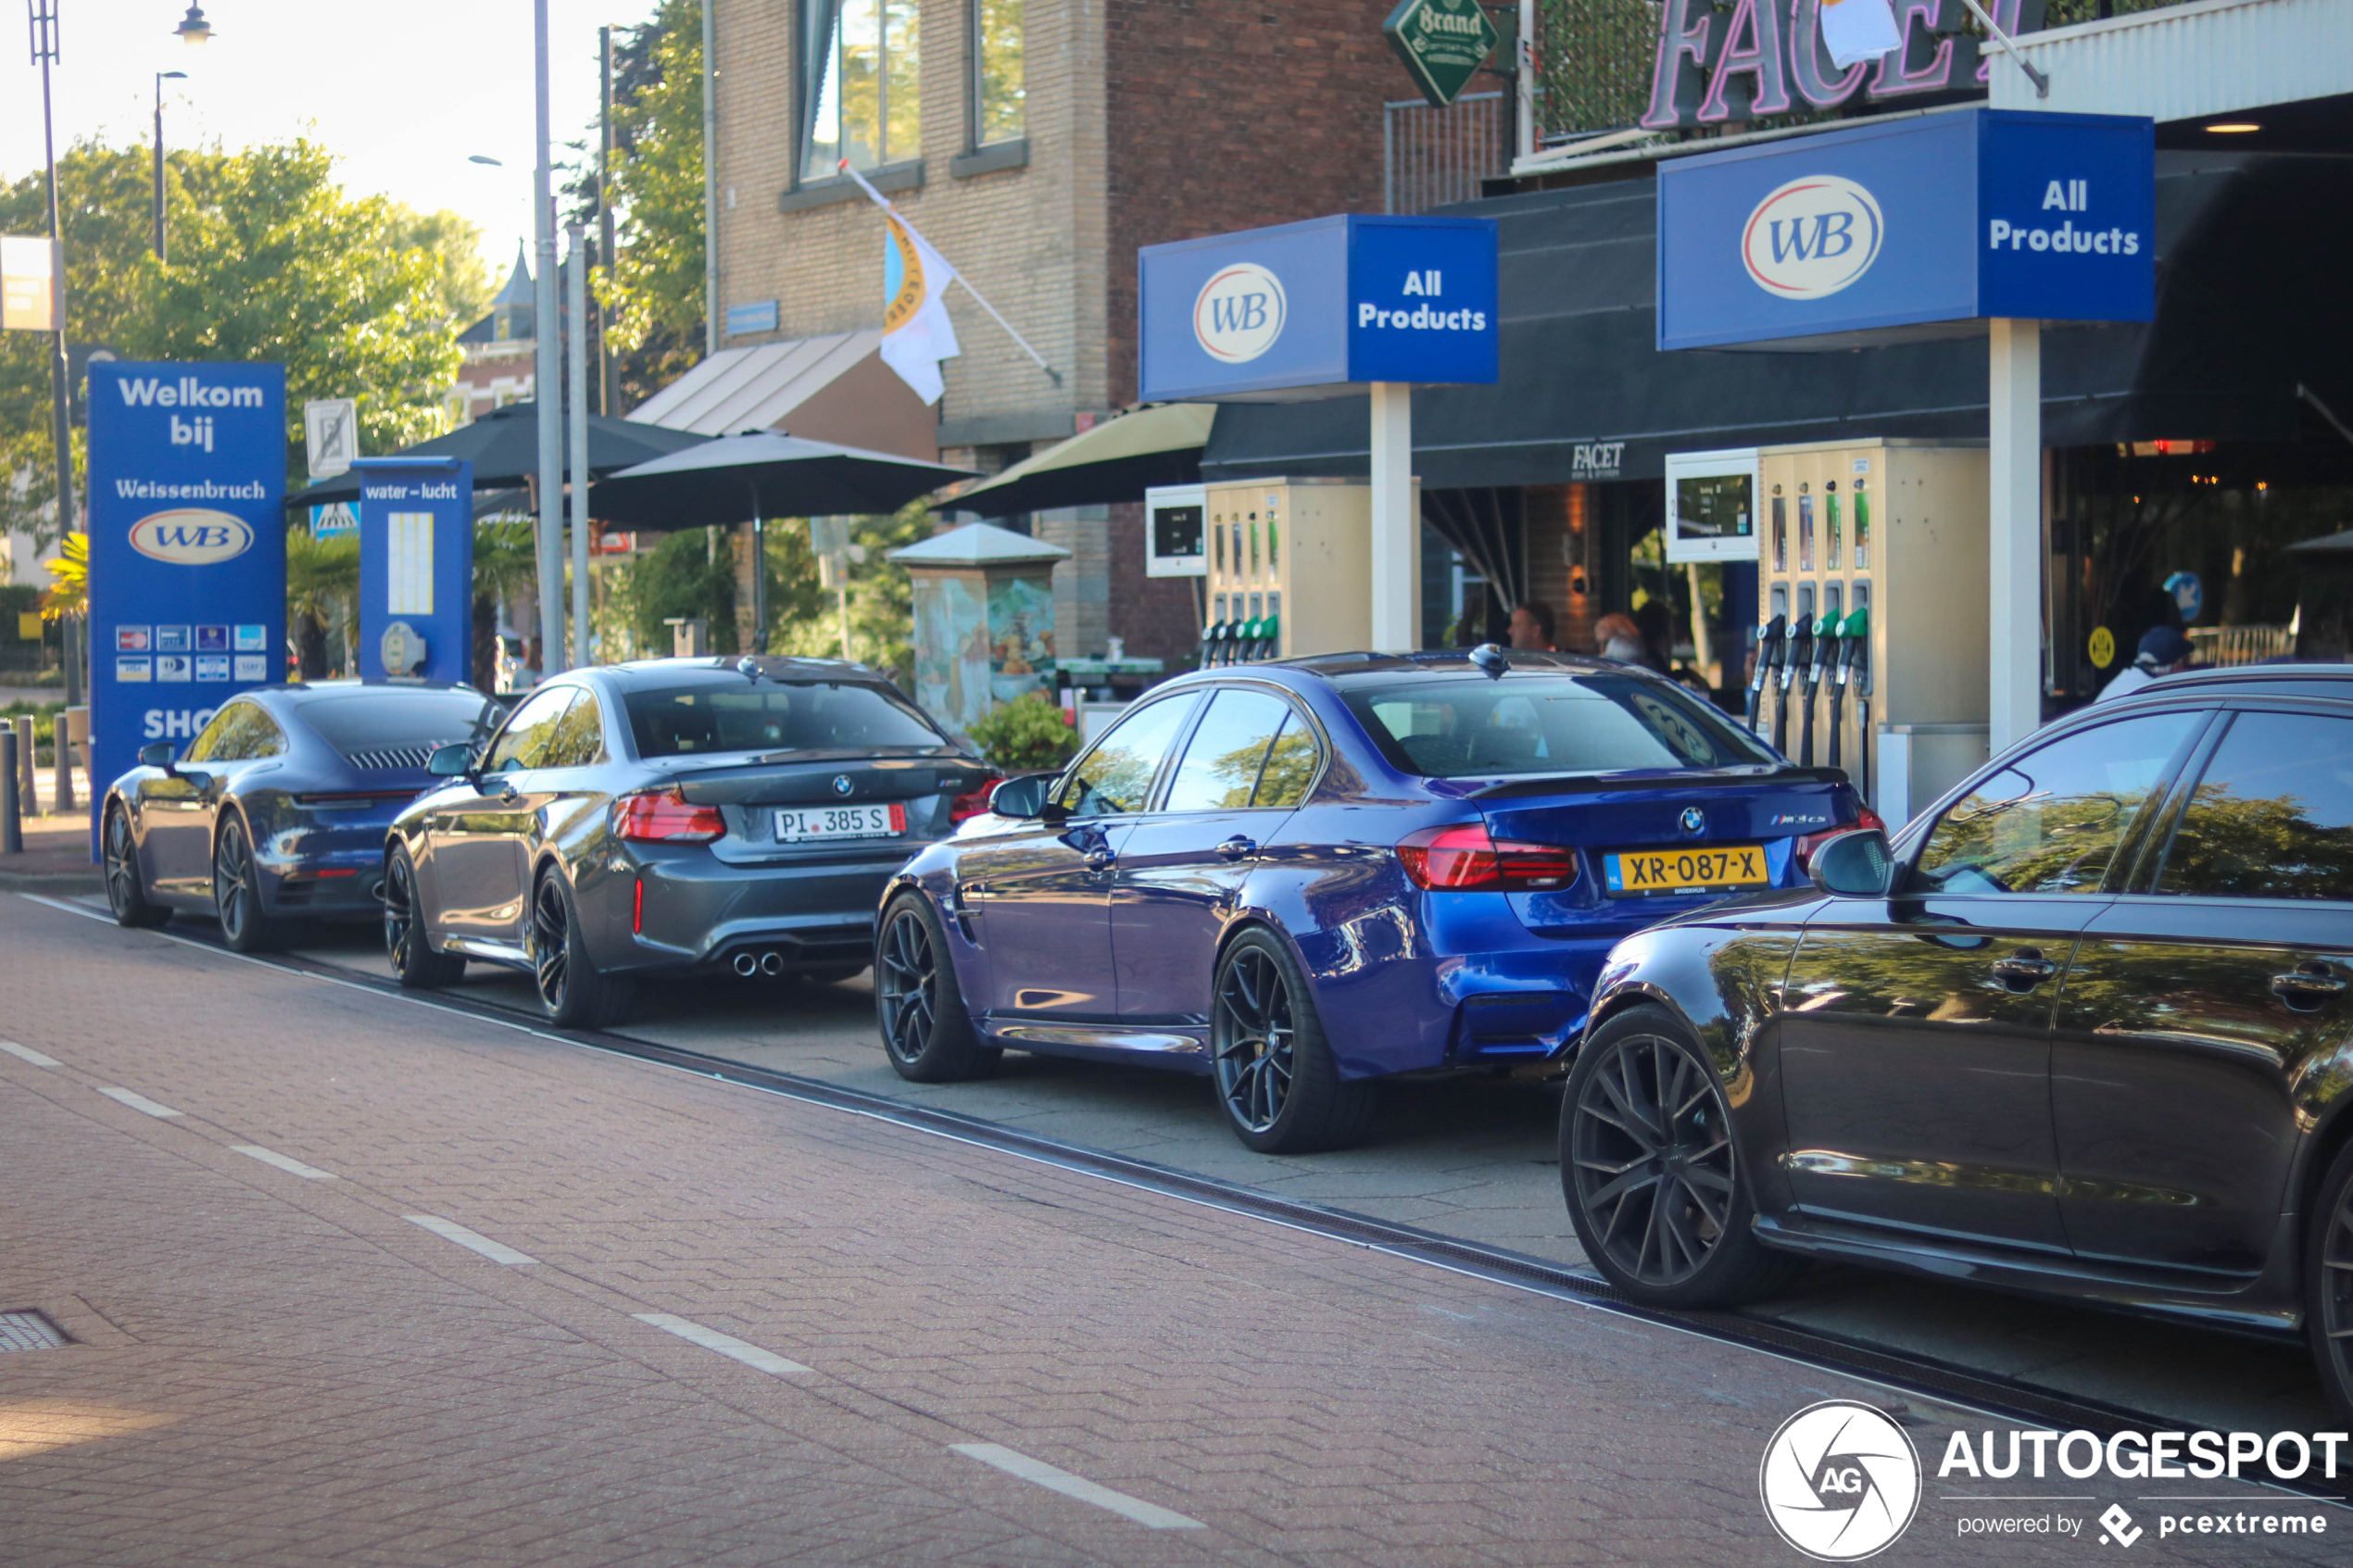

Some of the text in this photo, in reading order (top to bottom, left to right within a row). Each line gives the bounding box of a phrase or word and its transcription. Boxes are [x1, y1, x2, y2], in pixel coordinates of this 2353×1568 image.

[1419, 3, 1482, 35] Brand
[2042, 179, 2086, 211] All
[1769, 211, 1854, 264] WB
[1990, 220, 2139, 255] Products
[1403, 270, 1441, 296] All
[1212, 293, 1267, 333] WB
[1359, 303, 1486, 331] Products
[118, 377, 263, 408] Welkom
[170, 415, 213, 453] bij
[1572, 442, 1626, 470] FACET
[116, 480, 266, 499] Weissenbruch
[366, 484, 407, 499] water
[422, 483, 458, 499] lucht
[156, 526, 231, 547] WB
[144, 709, 217, 739] SHO
[782, 812, 808, 834] PI
[824, 809, 863, 832] 385
[870, 809, 884, 829] S
[1609, 876, 1621, 885] NL
[1630, 852, 1757, 884] XR-087-X
[1674, 886, 1706, 896] BROEKHUIS
